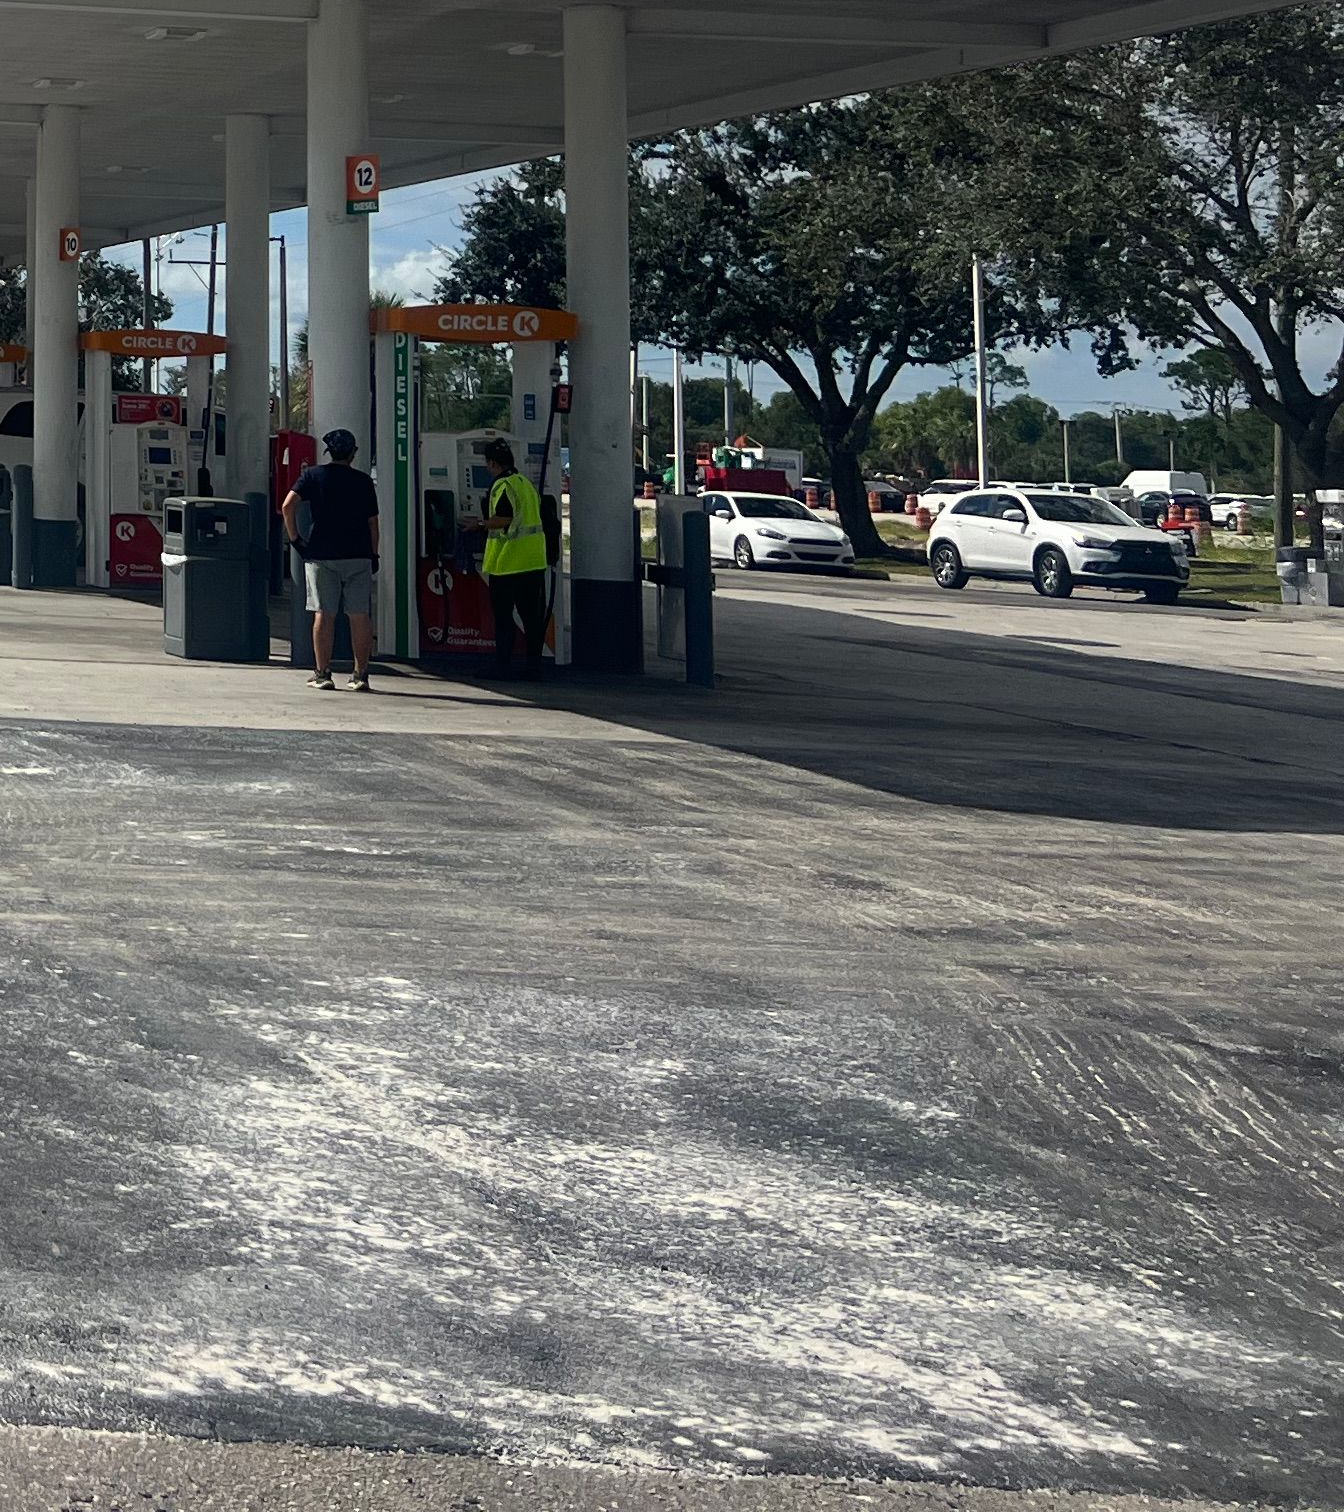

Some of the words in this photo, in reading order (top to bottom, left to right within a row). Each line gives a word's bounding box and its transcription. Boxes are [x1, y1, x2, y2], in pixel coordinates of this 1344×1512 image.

[357, 167, 373, 187] 12
[353, 201, 378, 211] DIESEL
[67, 238, 77, 251] 10
[438, 314, 509, 331] CIRCLE
[516, 313, 538, 336] K
[121, 335, 173, 348] CIRCLE
[179, 335, 196, 353] K
[394, 332, 408, 462] DIESEL
[118, 523, 134, 541] K
[447, 626, 480, 637] Quality
